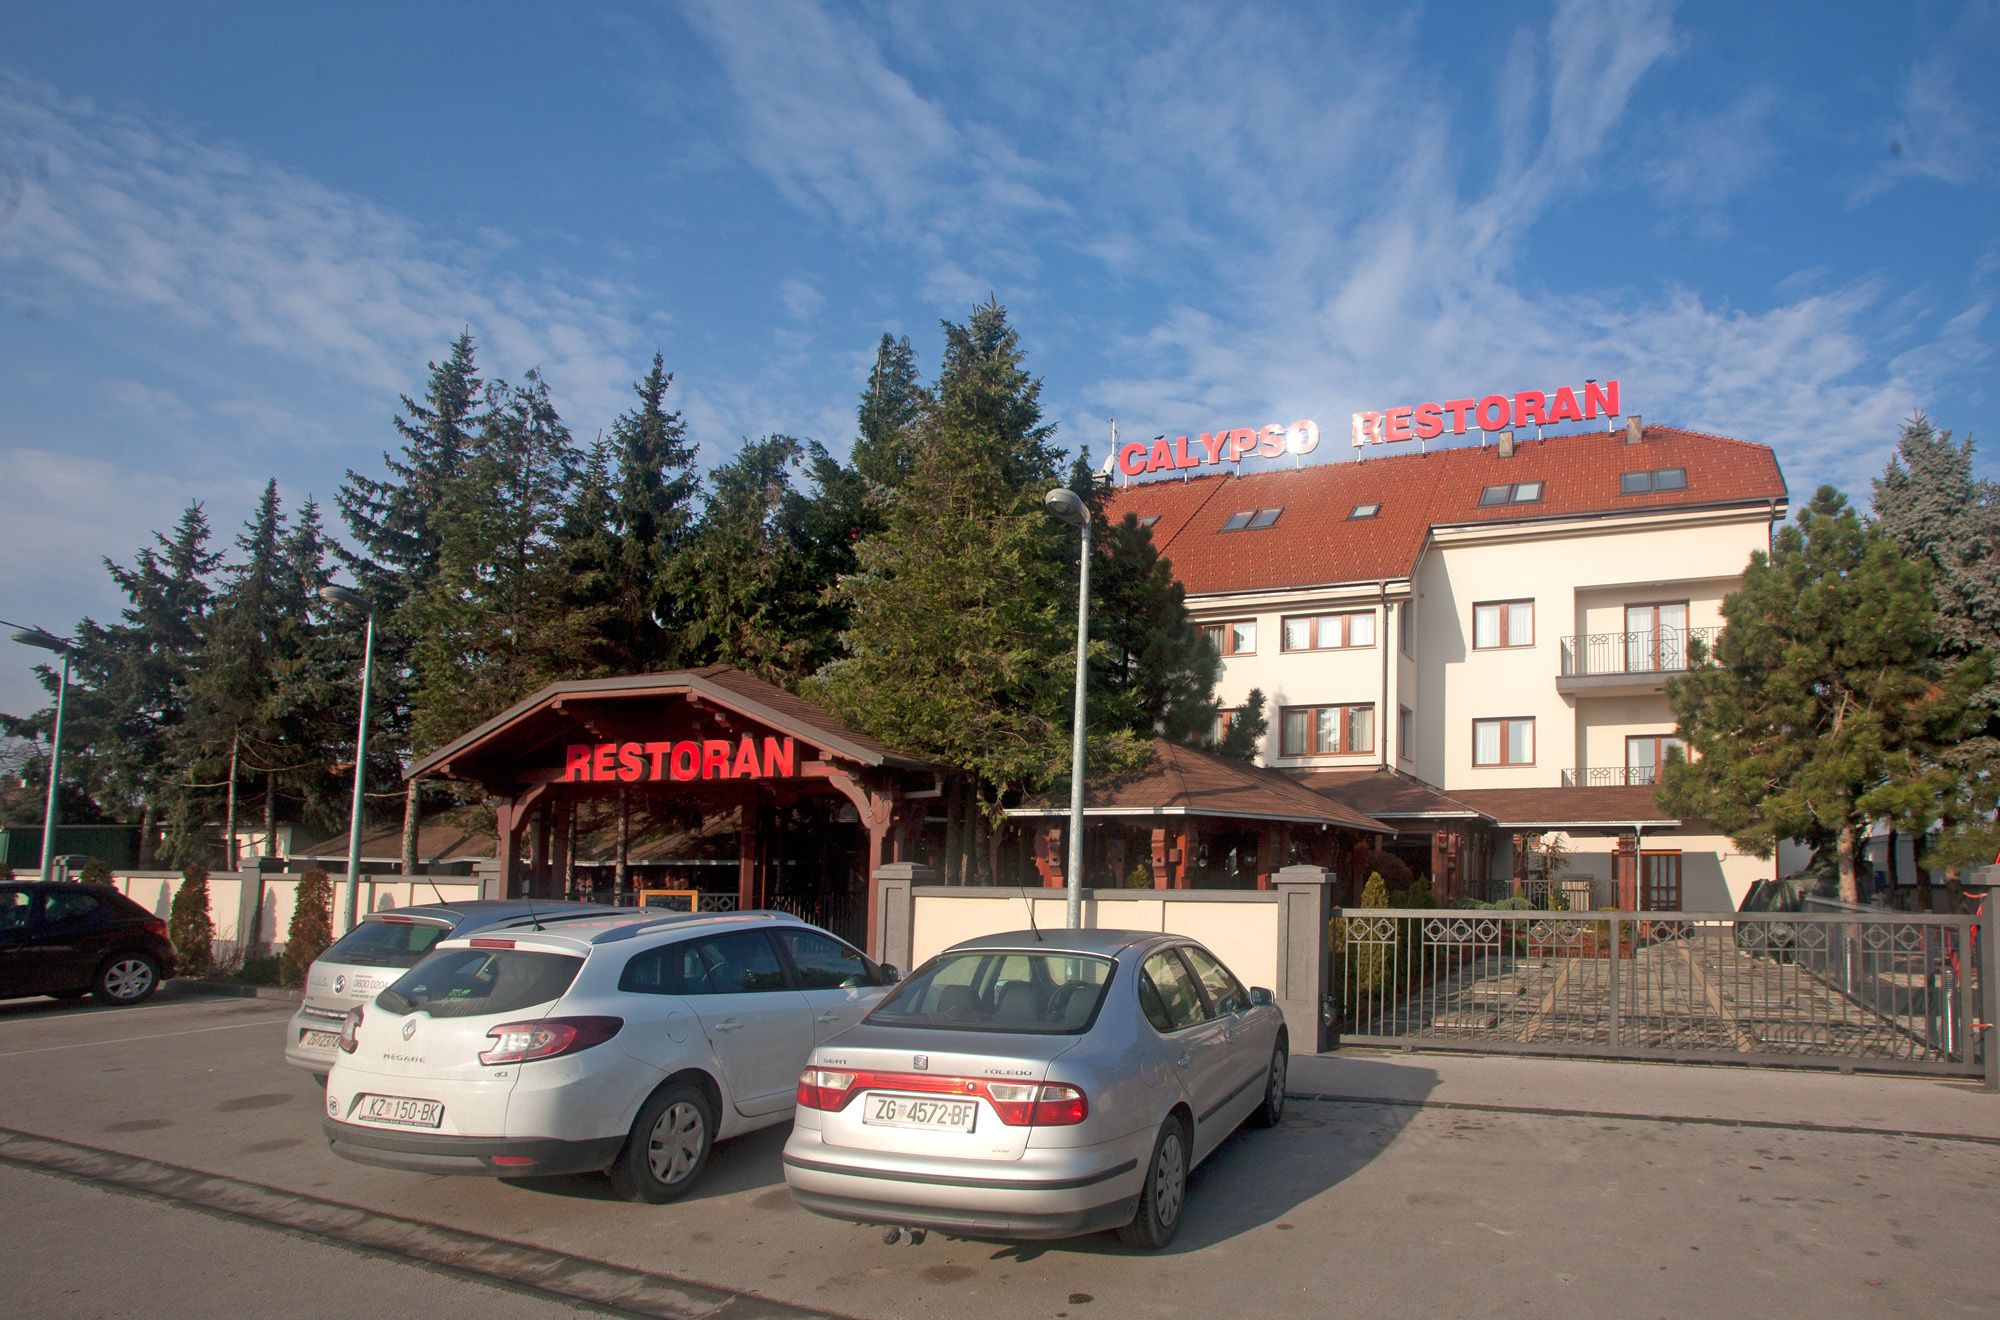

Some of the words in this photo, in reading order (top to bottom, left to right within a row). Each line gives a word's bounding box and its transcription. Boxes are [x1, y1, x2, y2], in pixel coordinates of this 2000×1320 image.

[1118, 418, 1319, 476] CALYPSO
[1352, 380, 1619, 447] RESTORAN
[565, 737, 795, 782] RESTORAN
[383, 1053, 426, 1063] MEGANE
[984, 1068, 1032, 1076] TOLEDO
[875, 1099, 897, 1120] ZG
